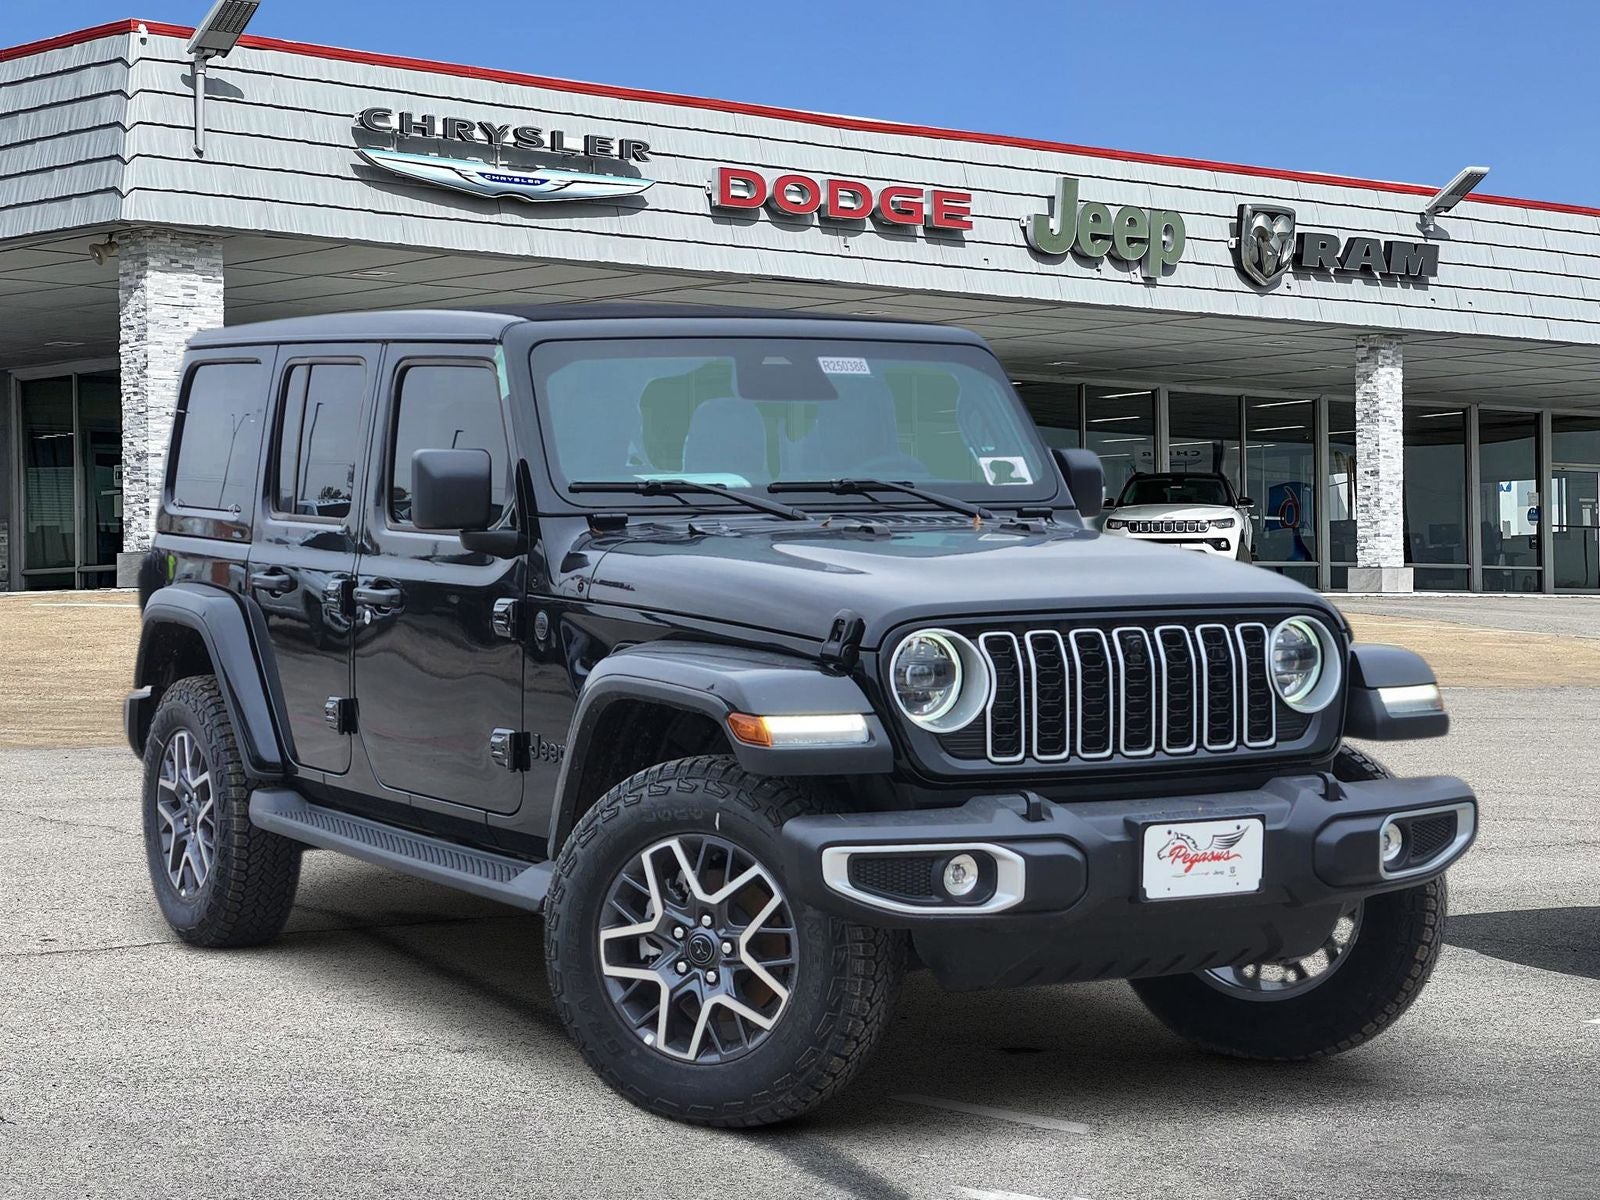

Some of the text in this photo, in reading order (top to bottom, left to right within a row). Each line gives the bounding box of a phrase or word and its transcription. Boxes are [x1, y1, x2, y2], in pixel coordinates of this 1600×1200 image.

[358, 107, 651, 162] CHRYSLER
[484, 174, 541, 184] CHRYSLER
[711, 167, 973, 230] DODGE
[1025, 177, 1186, 278] Jeep
[1299, 231, 1439, 277] RAM
[1168, 845, 1242, 873] Pegasus
